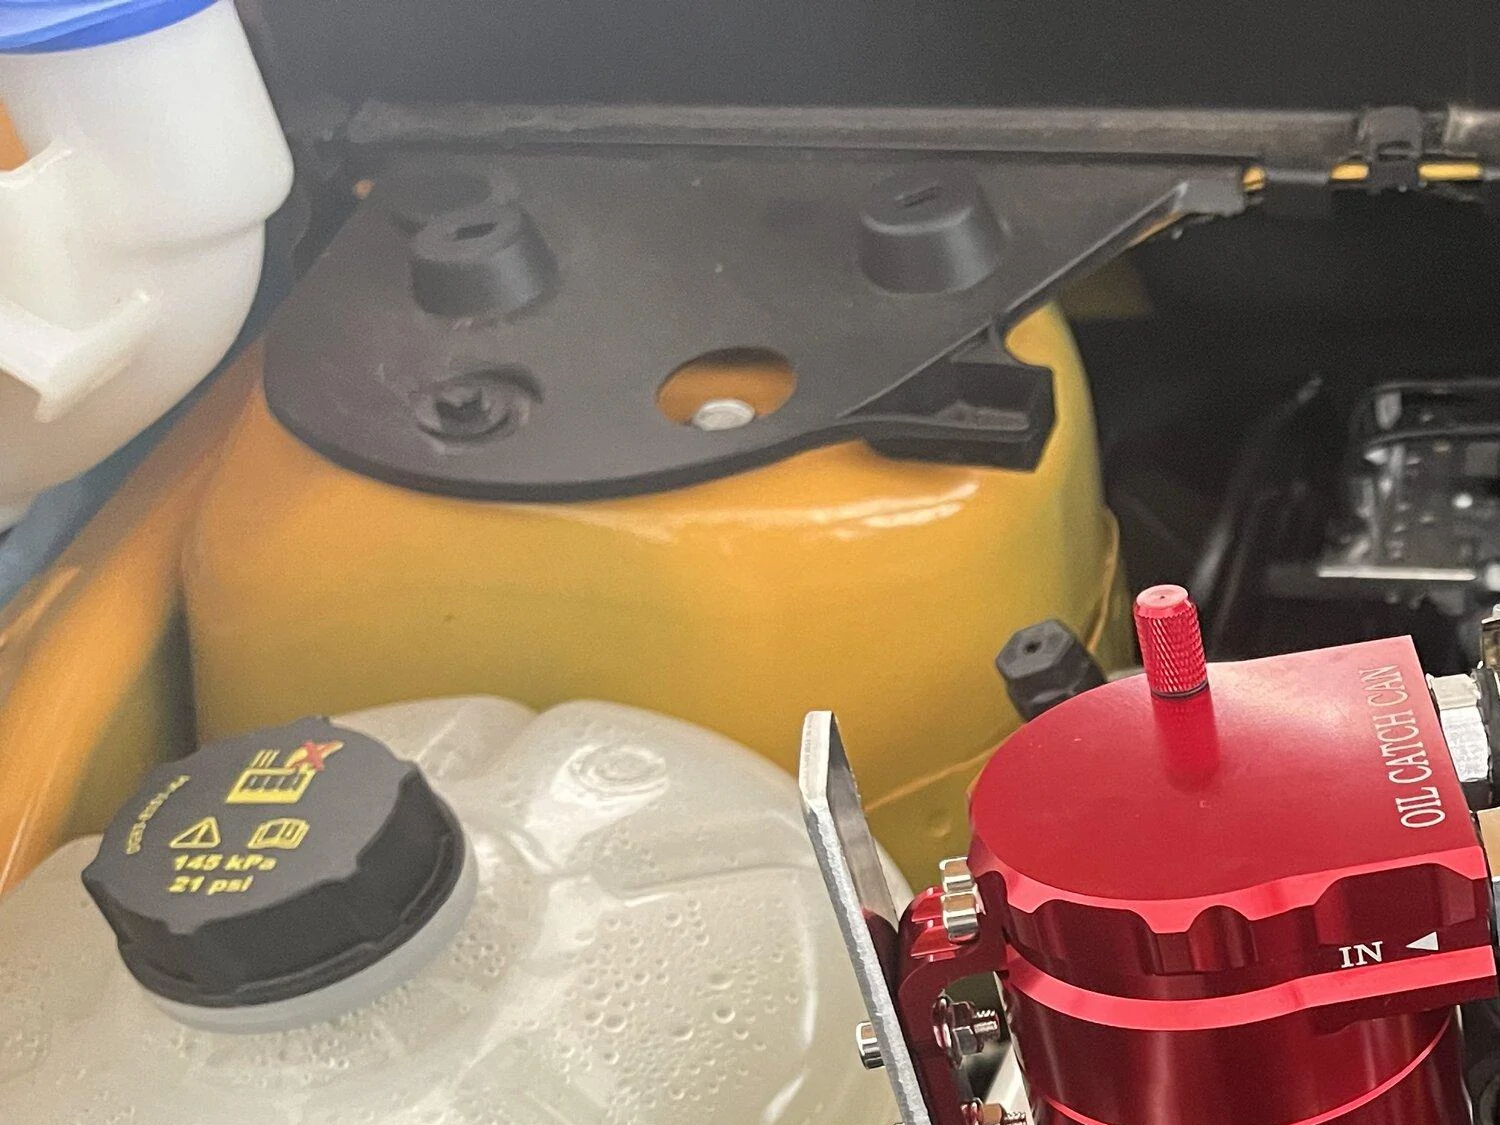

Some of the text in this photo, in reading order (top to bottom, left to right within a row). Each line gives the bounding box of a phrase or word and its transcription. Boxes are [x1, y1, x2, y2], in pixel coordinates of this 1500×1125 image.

[1358, 664, 1446, 829] OIL CATCH CAN
[224, 854, 278, 872] kPa
[168, 875, 255, 897] 21 psi
[1338, 940, 1384, 969] IN
